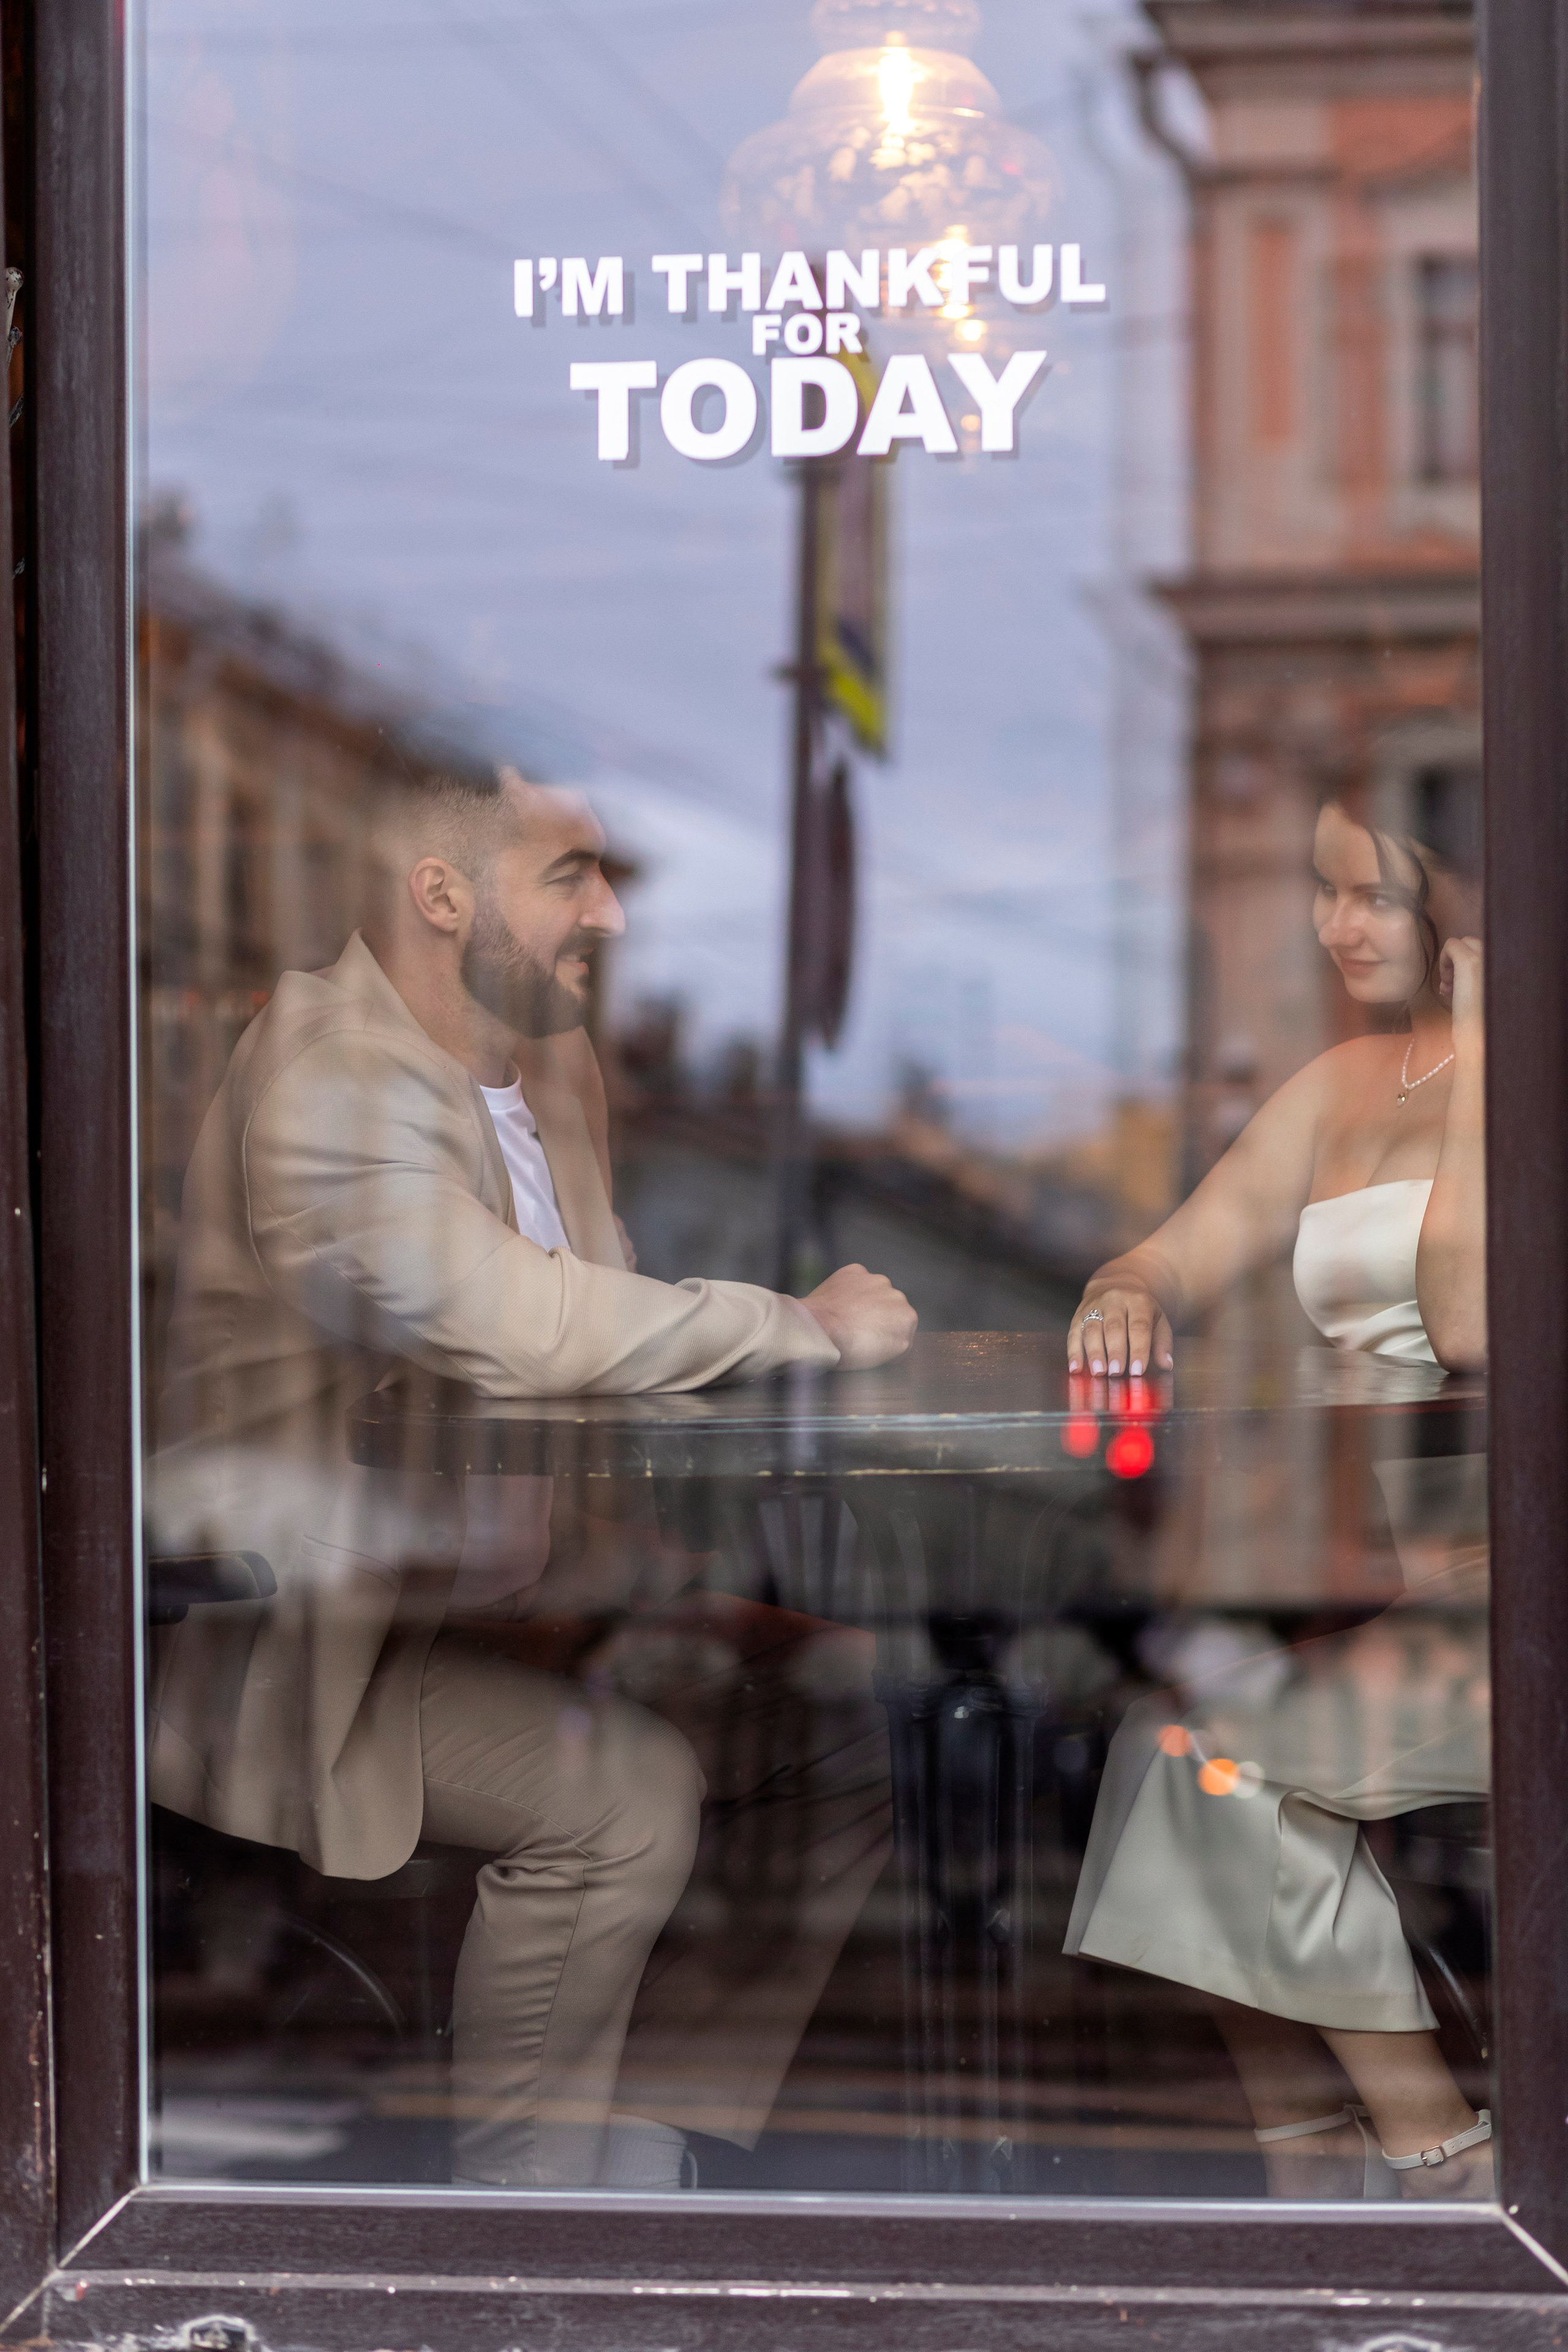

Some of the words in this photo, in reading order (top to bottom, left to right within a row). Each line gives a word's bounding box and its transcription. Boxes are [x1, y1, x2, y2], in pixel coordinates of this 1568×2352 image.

[514, 255, 624, 317] I'M
[651, 243, 1107, 313] THANKFUL
[752, 312, 863, 356] FOR
[569, 350, 1048, 461] TODAY
